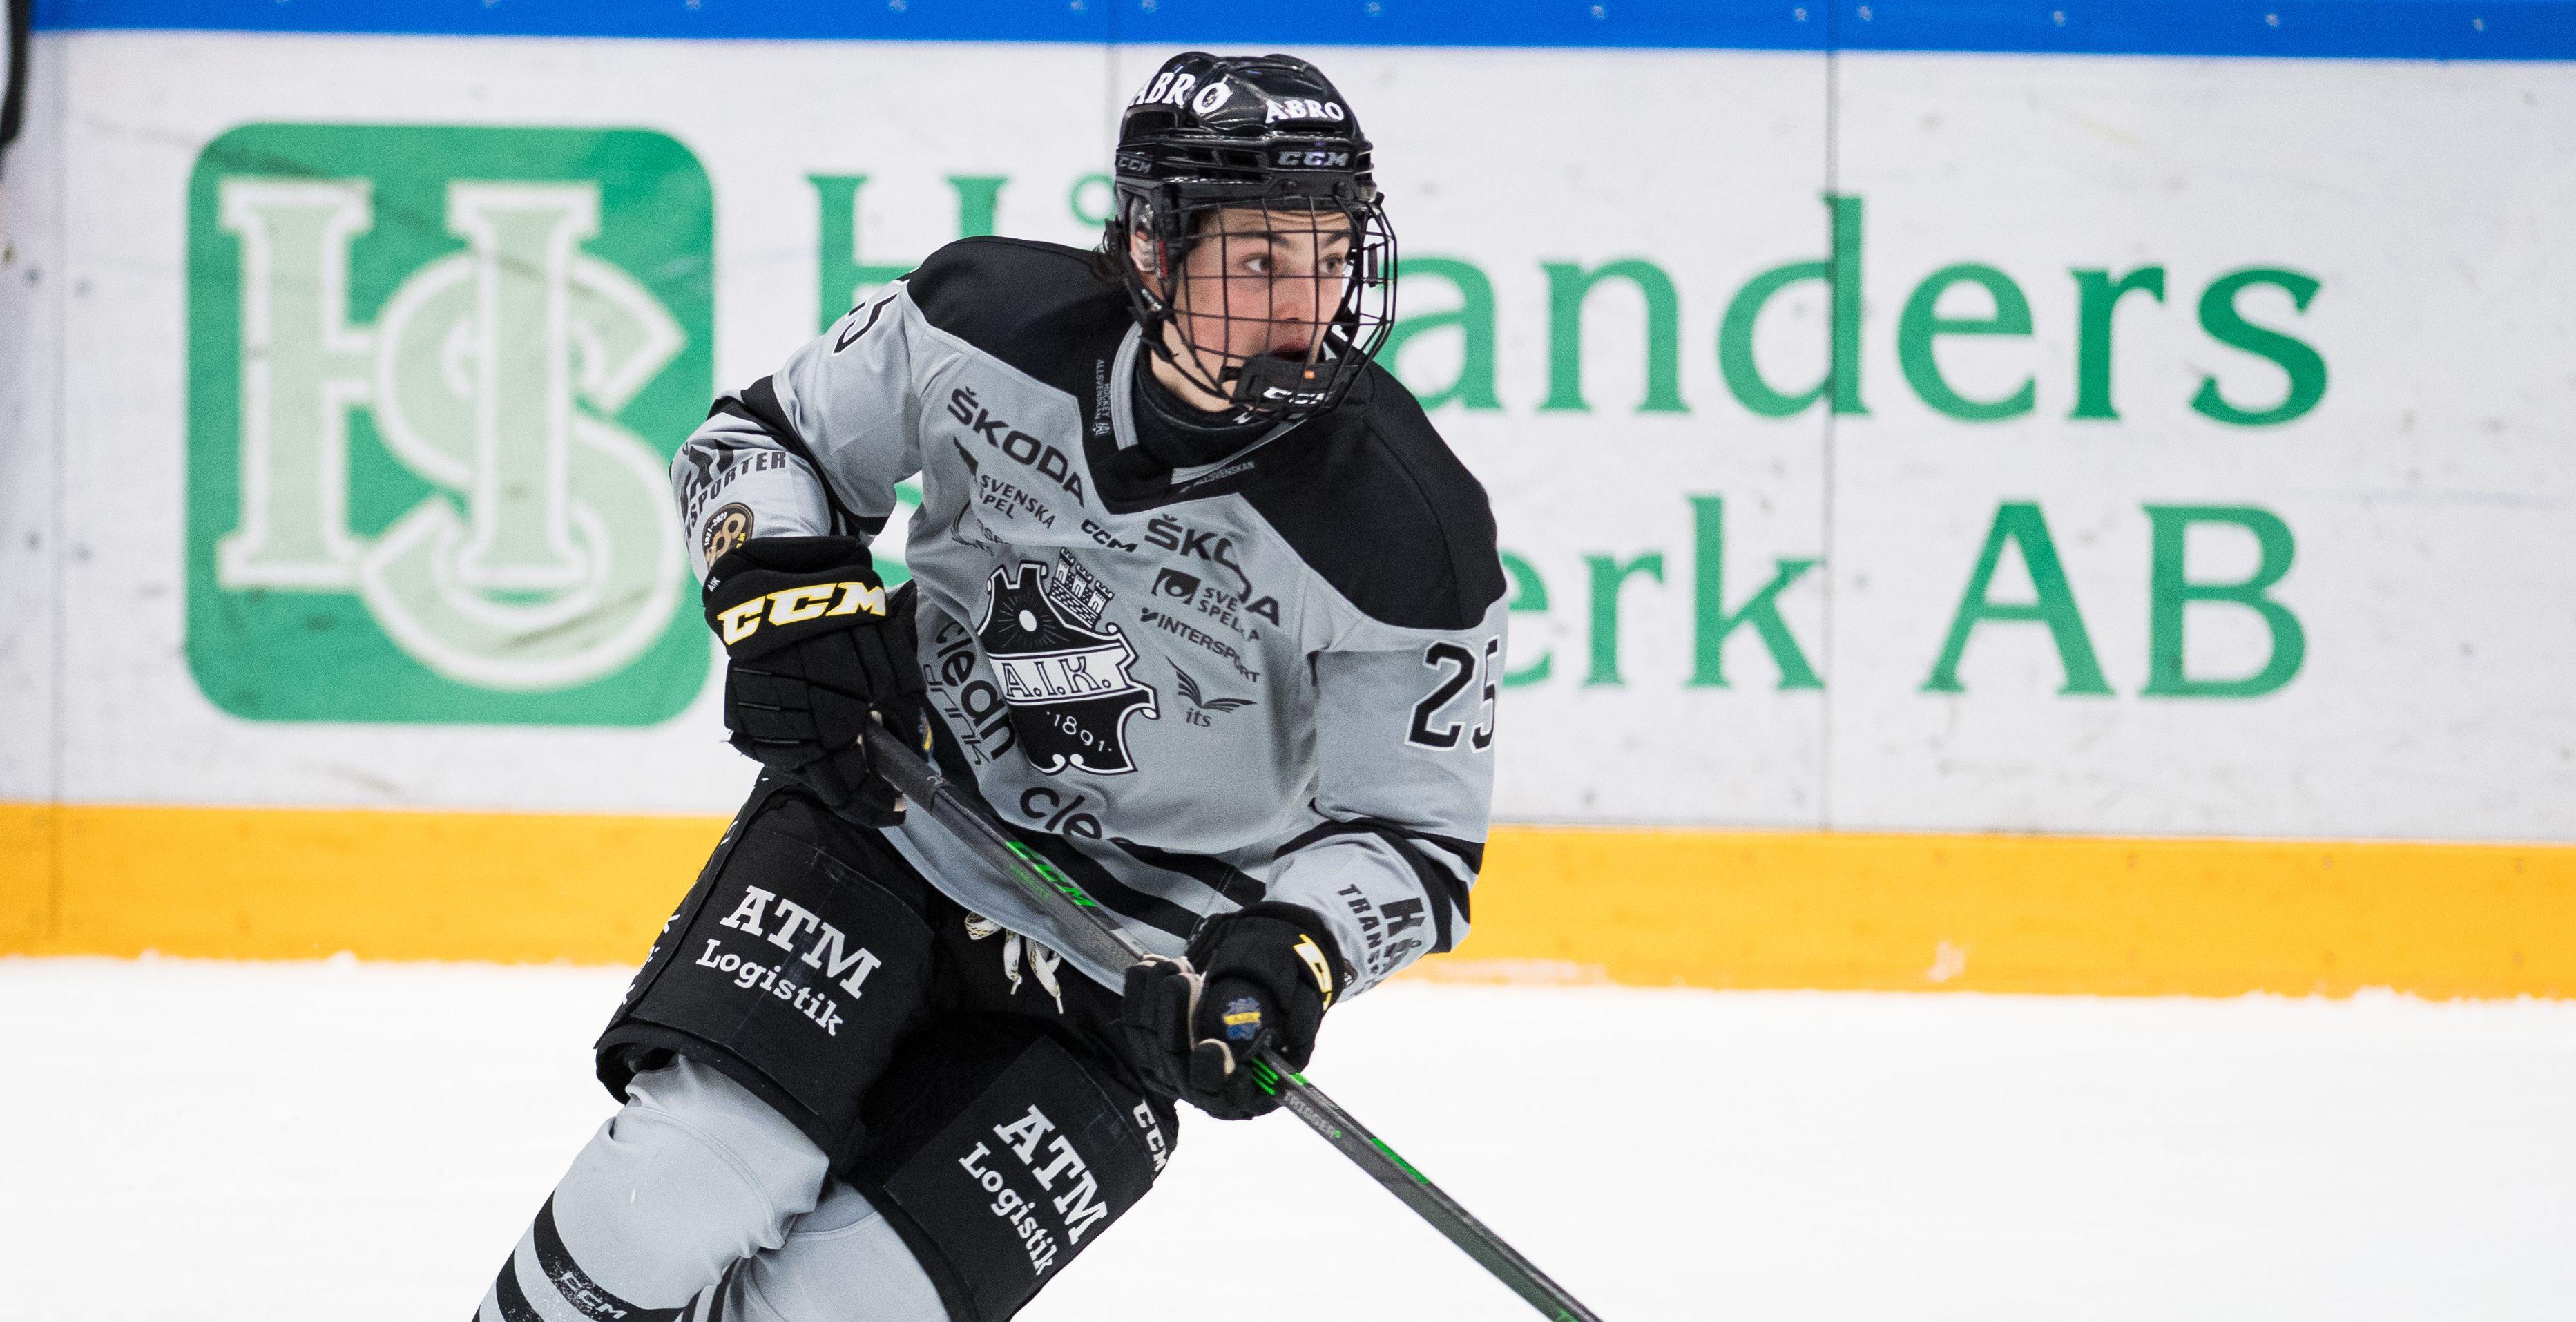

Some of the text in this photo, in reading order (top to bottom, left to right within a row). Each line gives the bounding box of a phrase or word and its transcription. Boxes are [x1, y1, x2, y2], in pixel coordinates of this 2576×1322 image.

[1118, 156, 1151, 173] CCM
[1278, 151, 1349, 166] CCM
[948, 387, 1084, 508] ŠKODA
[979, 487, 1014, 519] PEL
[980, 474, 1056, 529] SVENSKA
[1082, 519, 1138, 553] CCM
[707, 576, 721, 593] AIK
[717, 582, 886, 646] CCM
[1914, 501, 2308, 699] AB
[935, 620, 1017, 760] clean
[1001, 655, 1111, 698] A.I.K.
[1404, 635, 1500, 754] 25
[1185, 706, 1212, 727] its
[1020, 787, 1113, 841] cle
[1006, 841, 1098, 907] CCM
[720, 885, 882, 1000] ATM
[695, 938, 843, 1036] Logistik
[1133, 1098, 1167, 1173] CCM
[993, 1104, 1108, 1245] ATM
[959, 1141, 1057, 1276] Logistik
[560, 1270, 628, 1320] CCM
